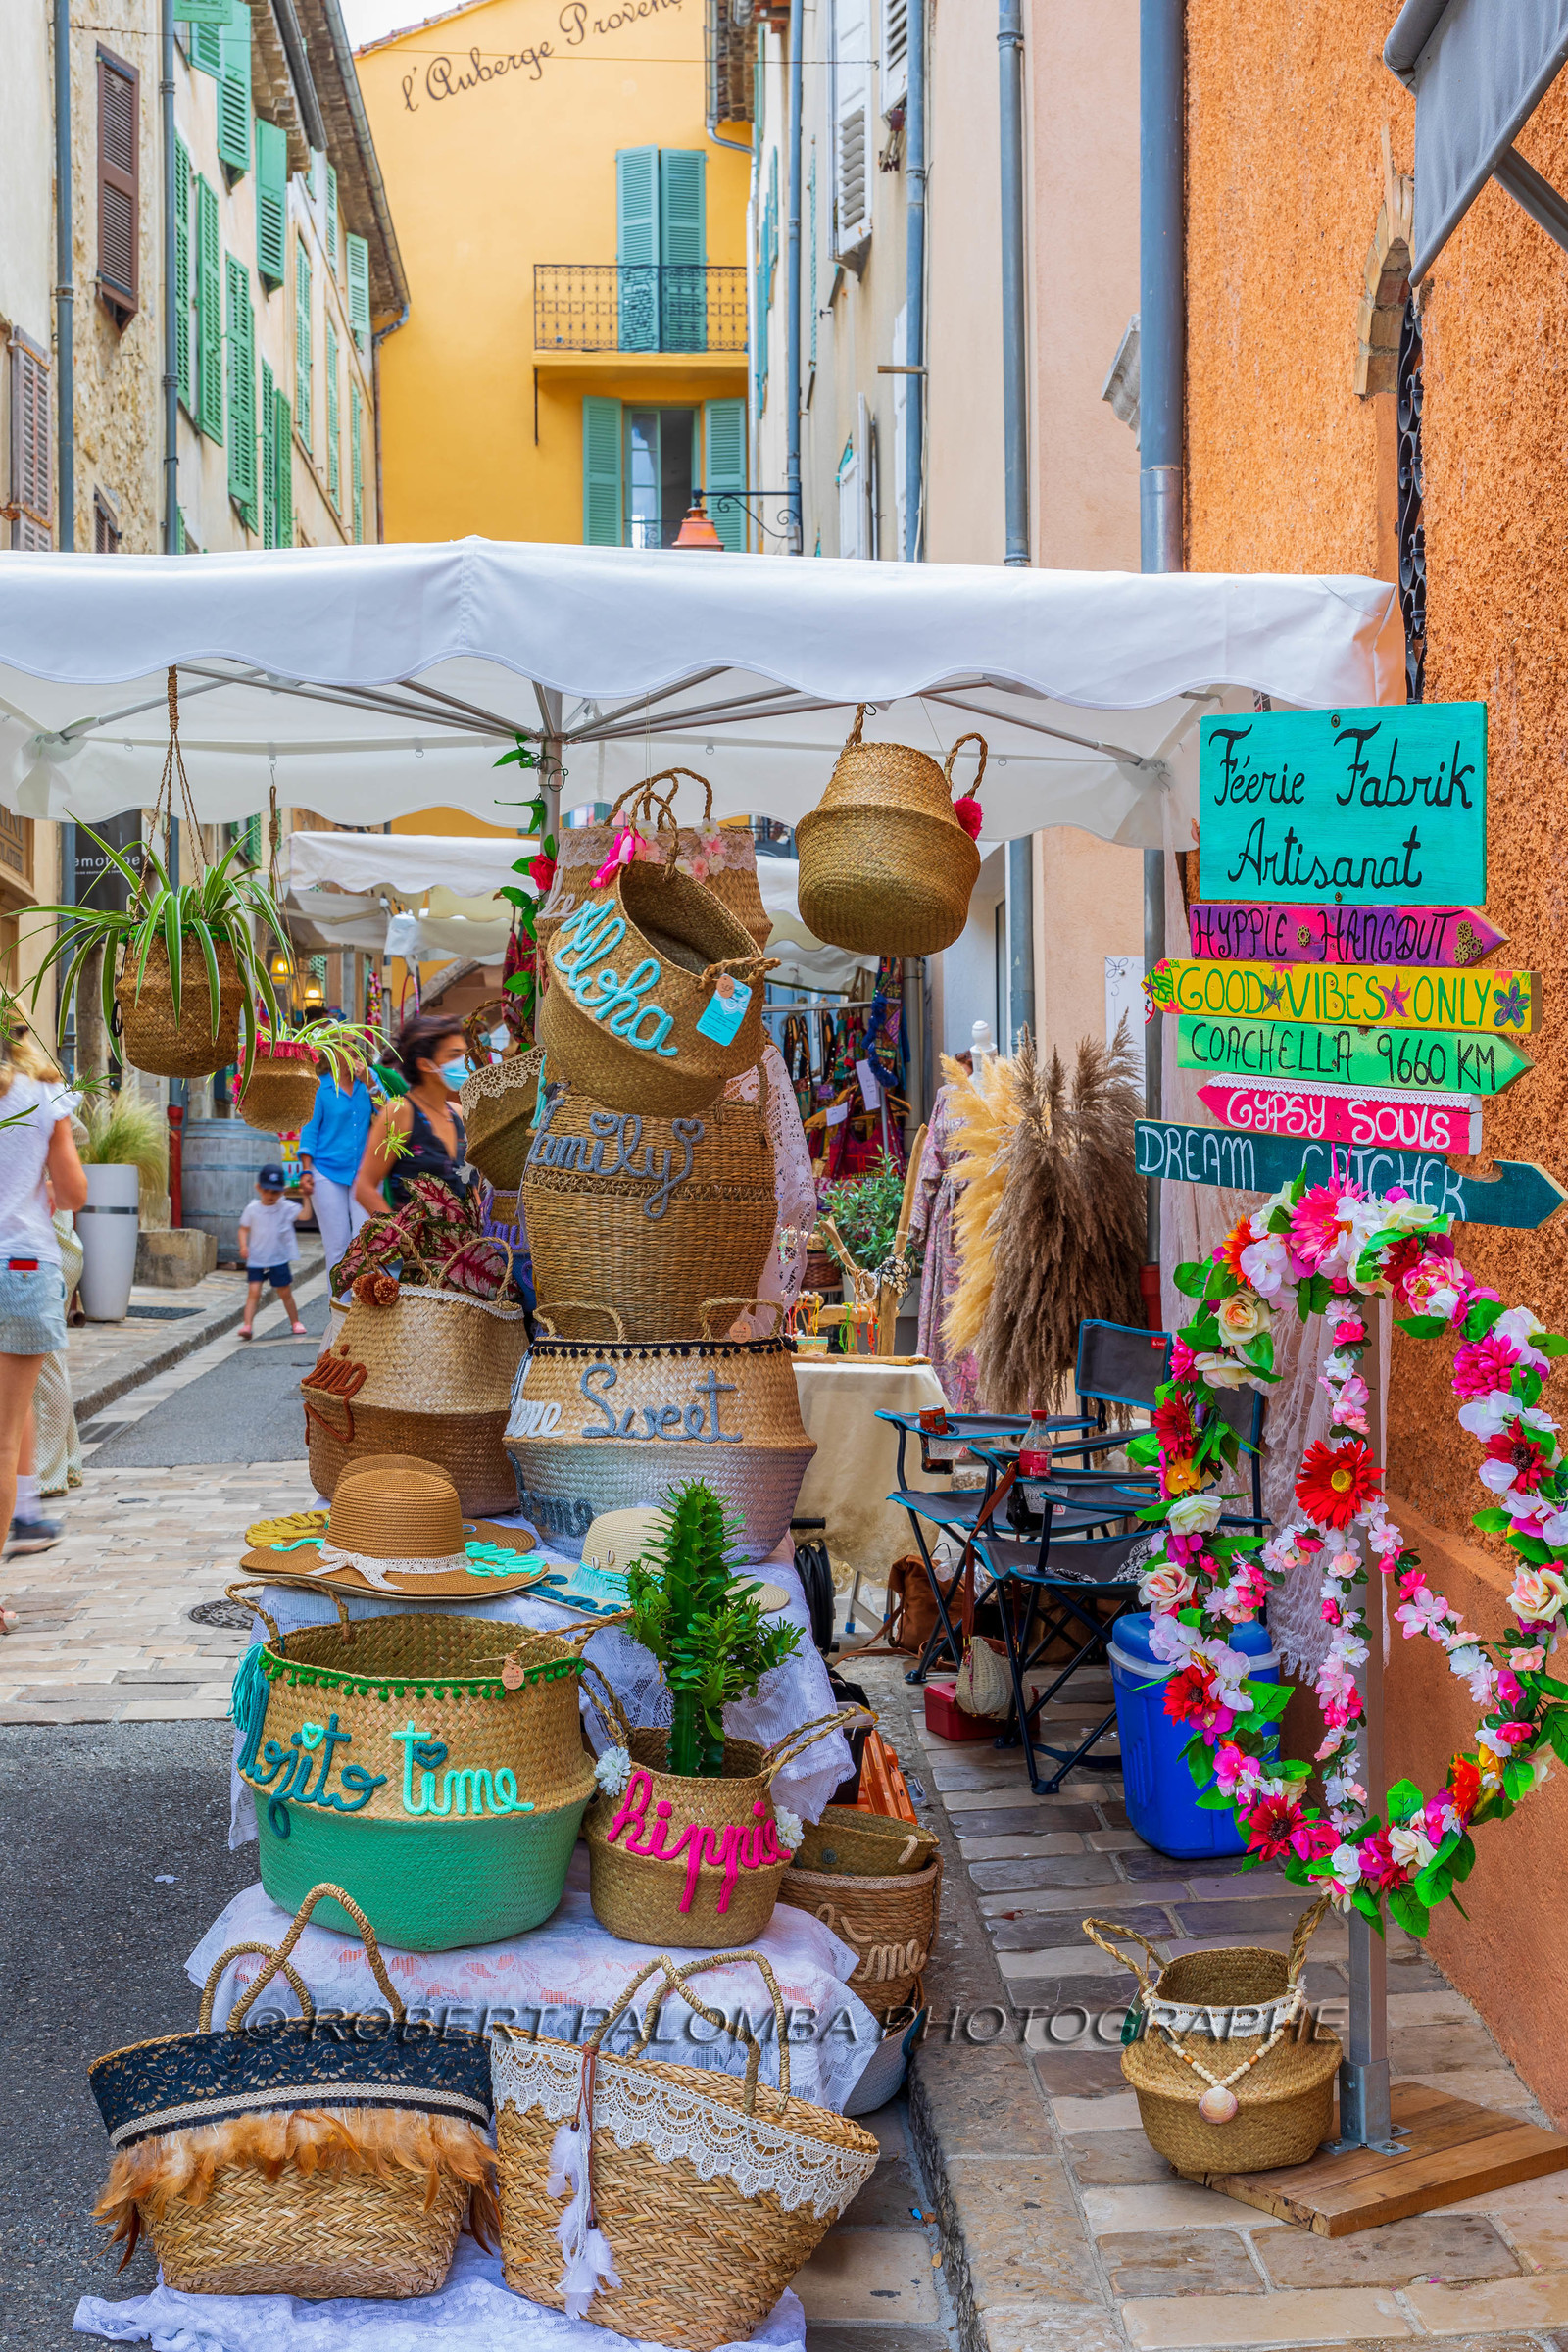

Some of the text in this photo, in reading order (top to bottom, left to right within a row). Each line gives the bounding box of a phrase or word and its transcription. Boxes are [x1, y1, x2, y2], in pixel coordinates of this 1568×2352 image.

[1208, 721, 1476, 809] Féerie Fabrik
[1227, 817, 1422, 890] Artisanat
[1316, 909, 1465, 962] HANGOUT
[553, 899, 679, 1057] Aloha
[1177, 966, 1492, 1027] GOOD VIBES ONLY
[1191, 1022, 1496, 1091] COACHELLA 9660 KM
[1225, 1090, 1452, 1150] GYPSY SOULS
[1138, 1125, 1465, 1222] DREAM CATCHER
[580, 1363, 744, 1445] Sweet
[391, 1720, 535, 1816] time
[607, 1770, 792, 1914] hippie
